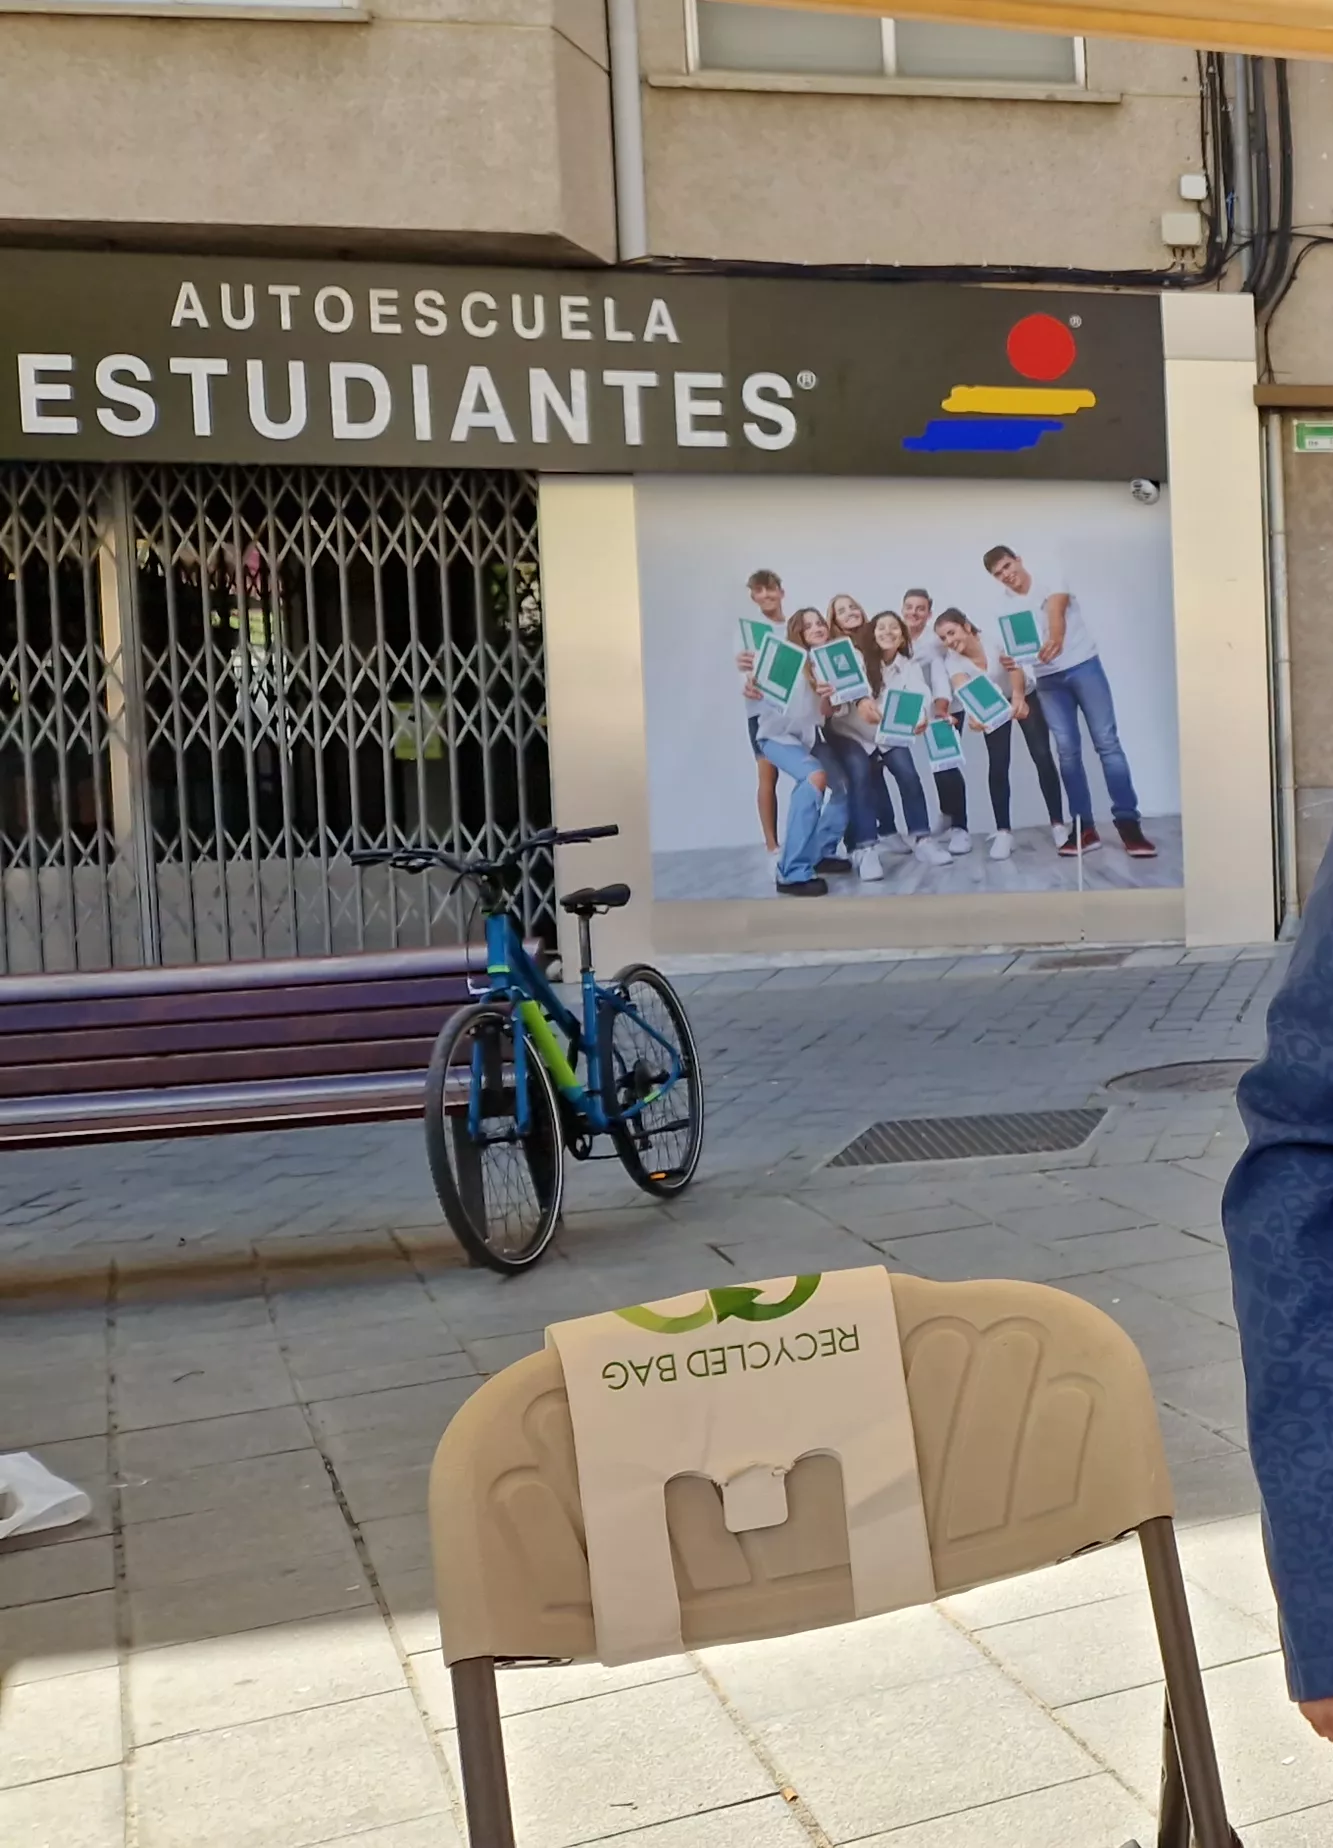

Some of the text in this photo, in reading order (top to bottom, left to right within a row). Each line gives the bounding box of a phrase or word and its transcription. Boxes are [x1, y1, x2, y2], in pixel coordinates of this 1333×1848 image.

[170, 281, 681, 344] AUTOESCUELA
[602, 1324, 860, 1390] RECYCLED BAG
